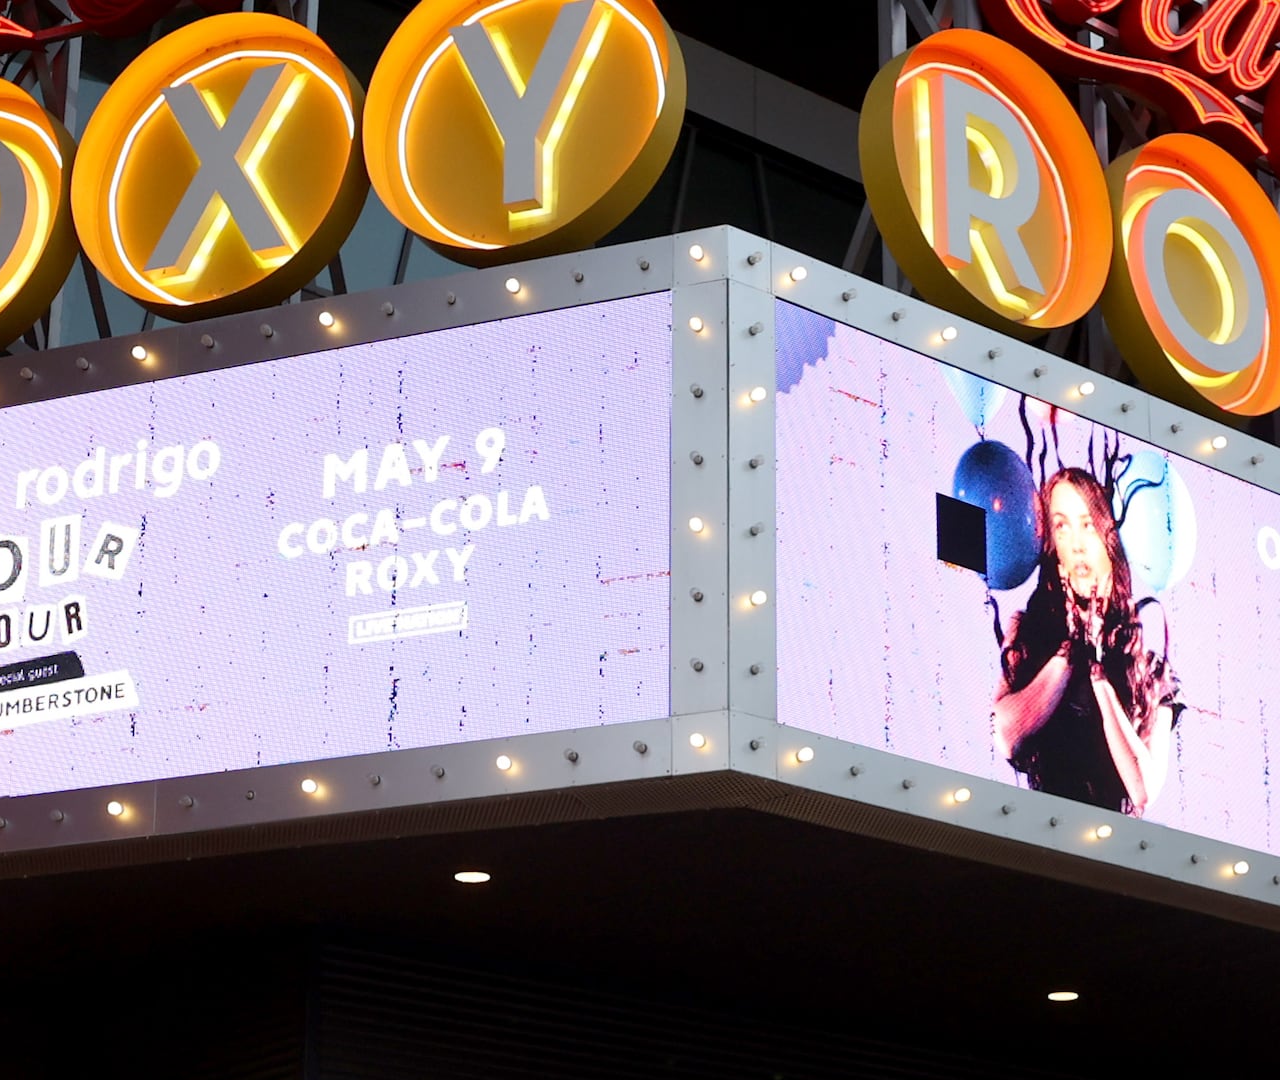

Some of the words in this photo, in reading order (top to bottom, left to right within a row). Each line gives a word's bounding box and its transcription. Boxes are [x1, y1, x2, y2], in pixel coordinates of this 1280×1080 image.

[15, 438, 221, 510] rodrigo
[322, 434, 452, 499] MAY
[475, 426, 507, 475] 9
[276, 484, 551, 560] COCA-COLA
[345, 544, 477, 598] ROXY
[27, 662, 60, 683] guest
